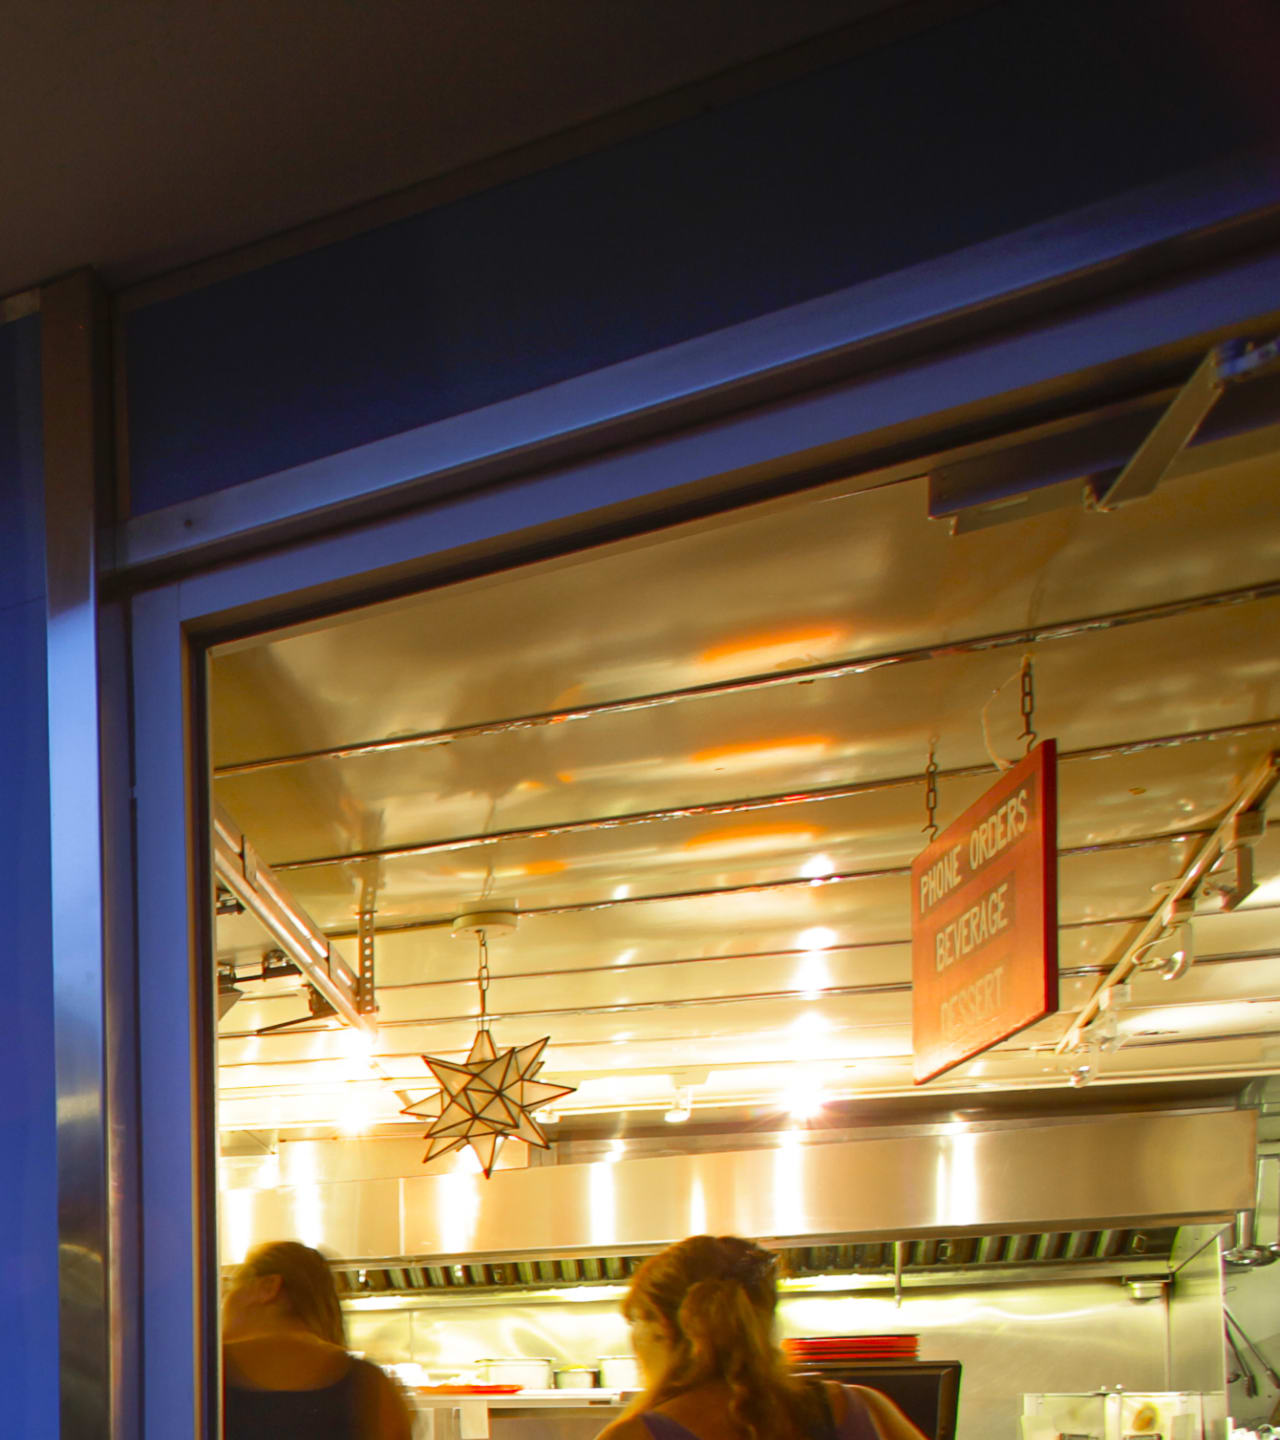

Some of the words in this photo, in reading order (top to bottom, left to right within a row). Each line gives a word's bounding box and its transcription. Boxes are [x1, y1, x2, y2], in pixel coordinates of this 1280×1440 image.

[920, 843, 962, 914] PHONE
[969, 789, 1028, 872] ORDERS
[935, 883, 1009, 973] BEVERAGE
[941, 966, 1005, 1035] DESSERT
